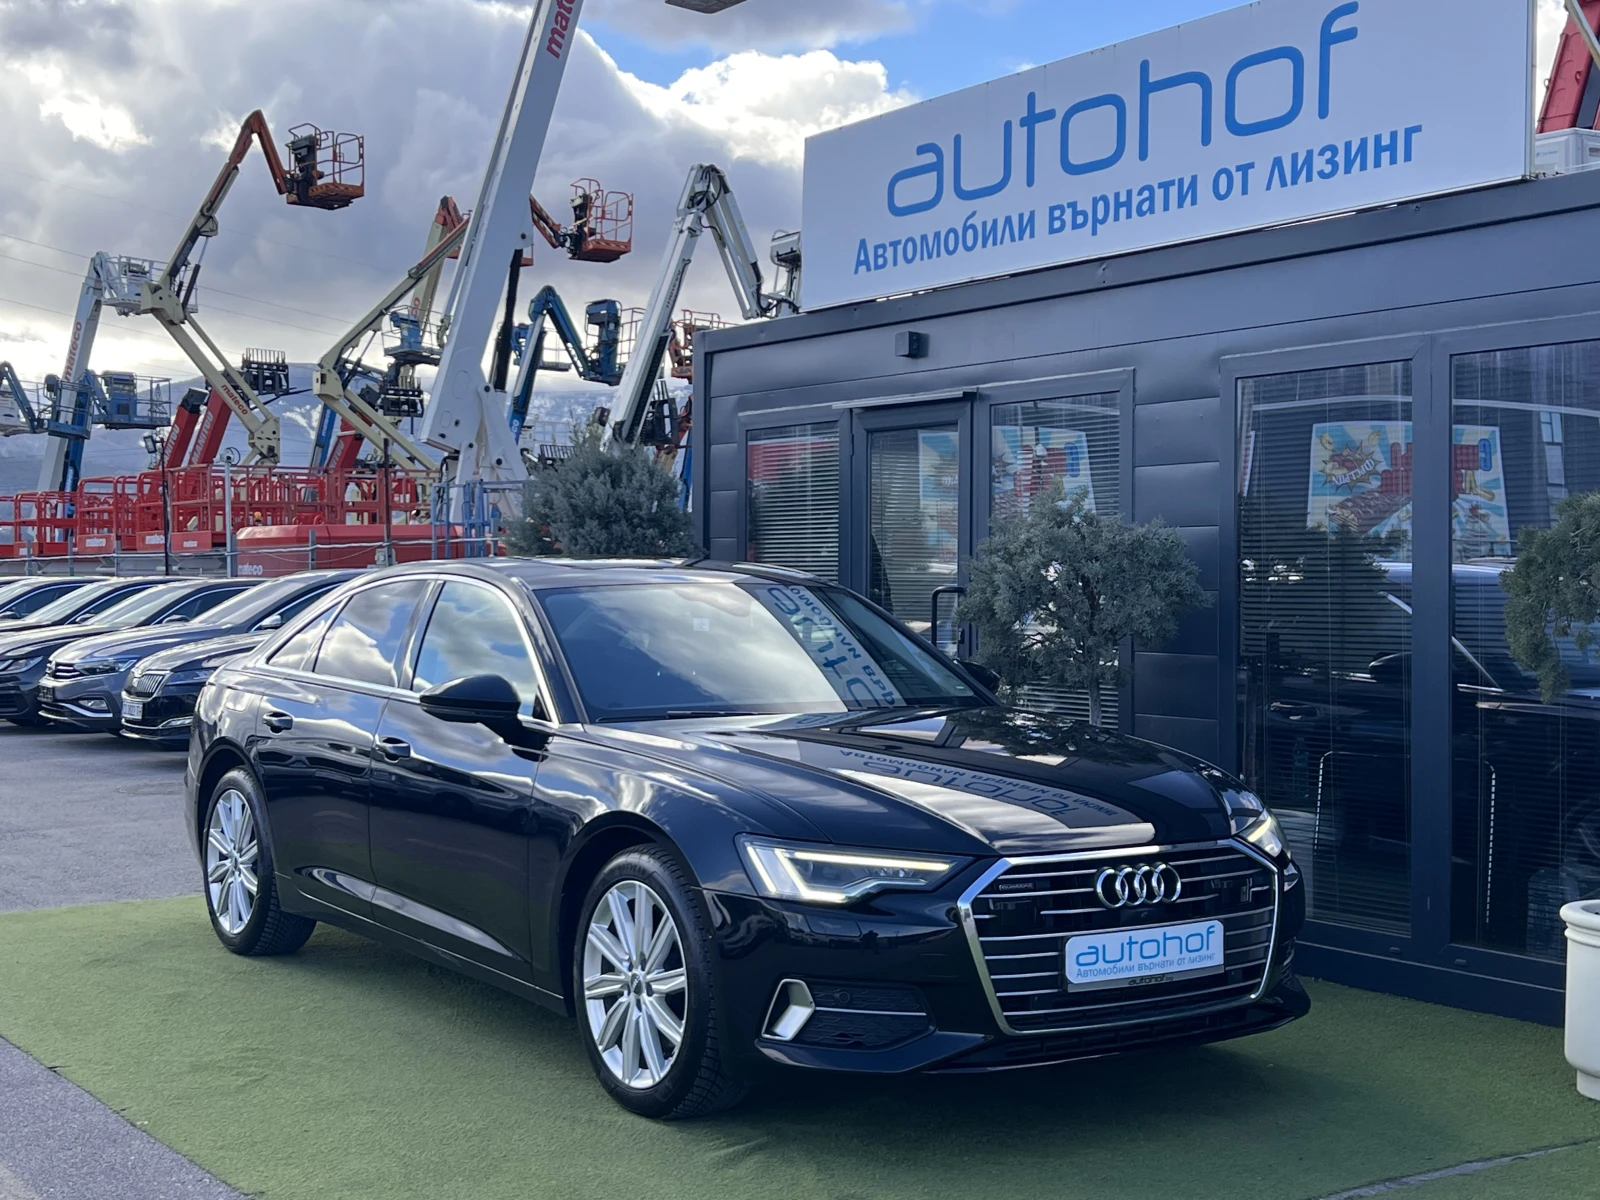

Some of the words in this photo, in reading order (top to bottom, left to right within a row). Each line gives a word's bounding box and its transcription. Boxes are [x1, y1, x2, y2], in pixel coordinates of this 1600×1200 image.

[887, 1, 1359, 217] autohof
[853, 210, 1036, 275] Автомобили
[1047, 173, 1198, 237] върнати
[1212, 161, 1255, 201] от
[1265, 124, 1423, 191] лизинг
[64, 321, 83, 382] mateco
[221, 384, 248, 415] mateco
[1075, 925, 1216, 967] autohof
[1076, 964, 1135, 979] Автомобили
[1137, 959, 1175, 974] върнати
[1176, 957, 1186, 967] от
[1187, 952, 1216, 965] лизинг
